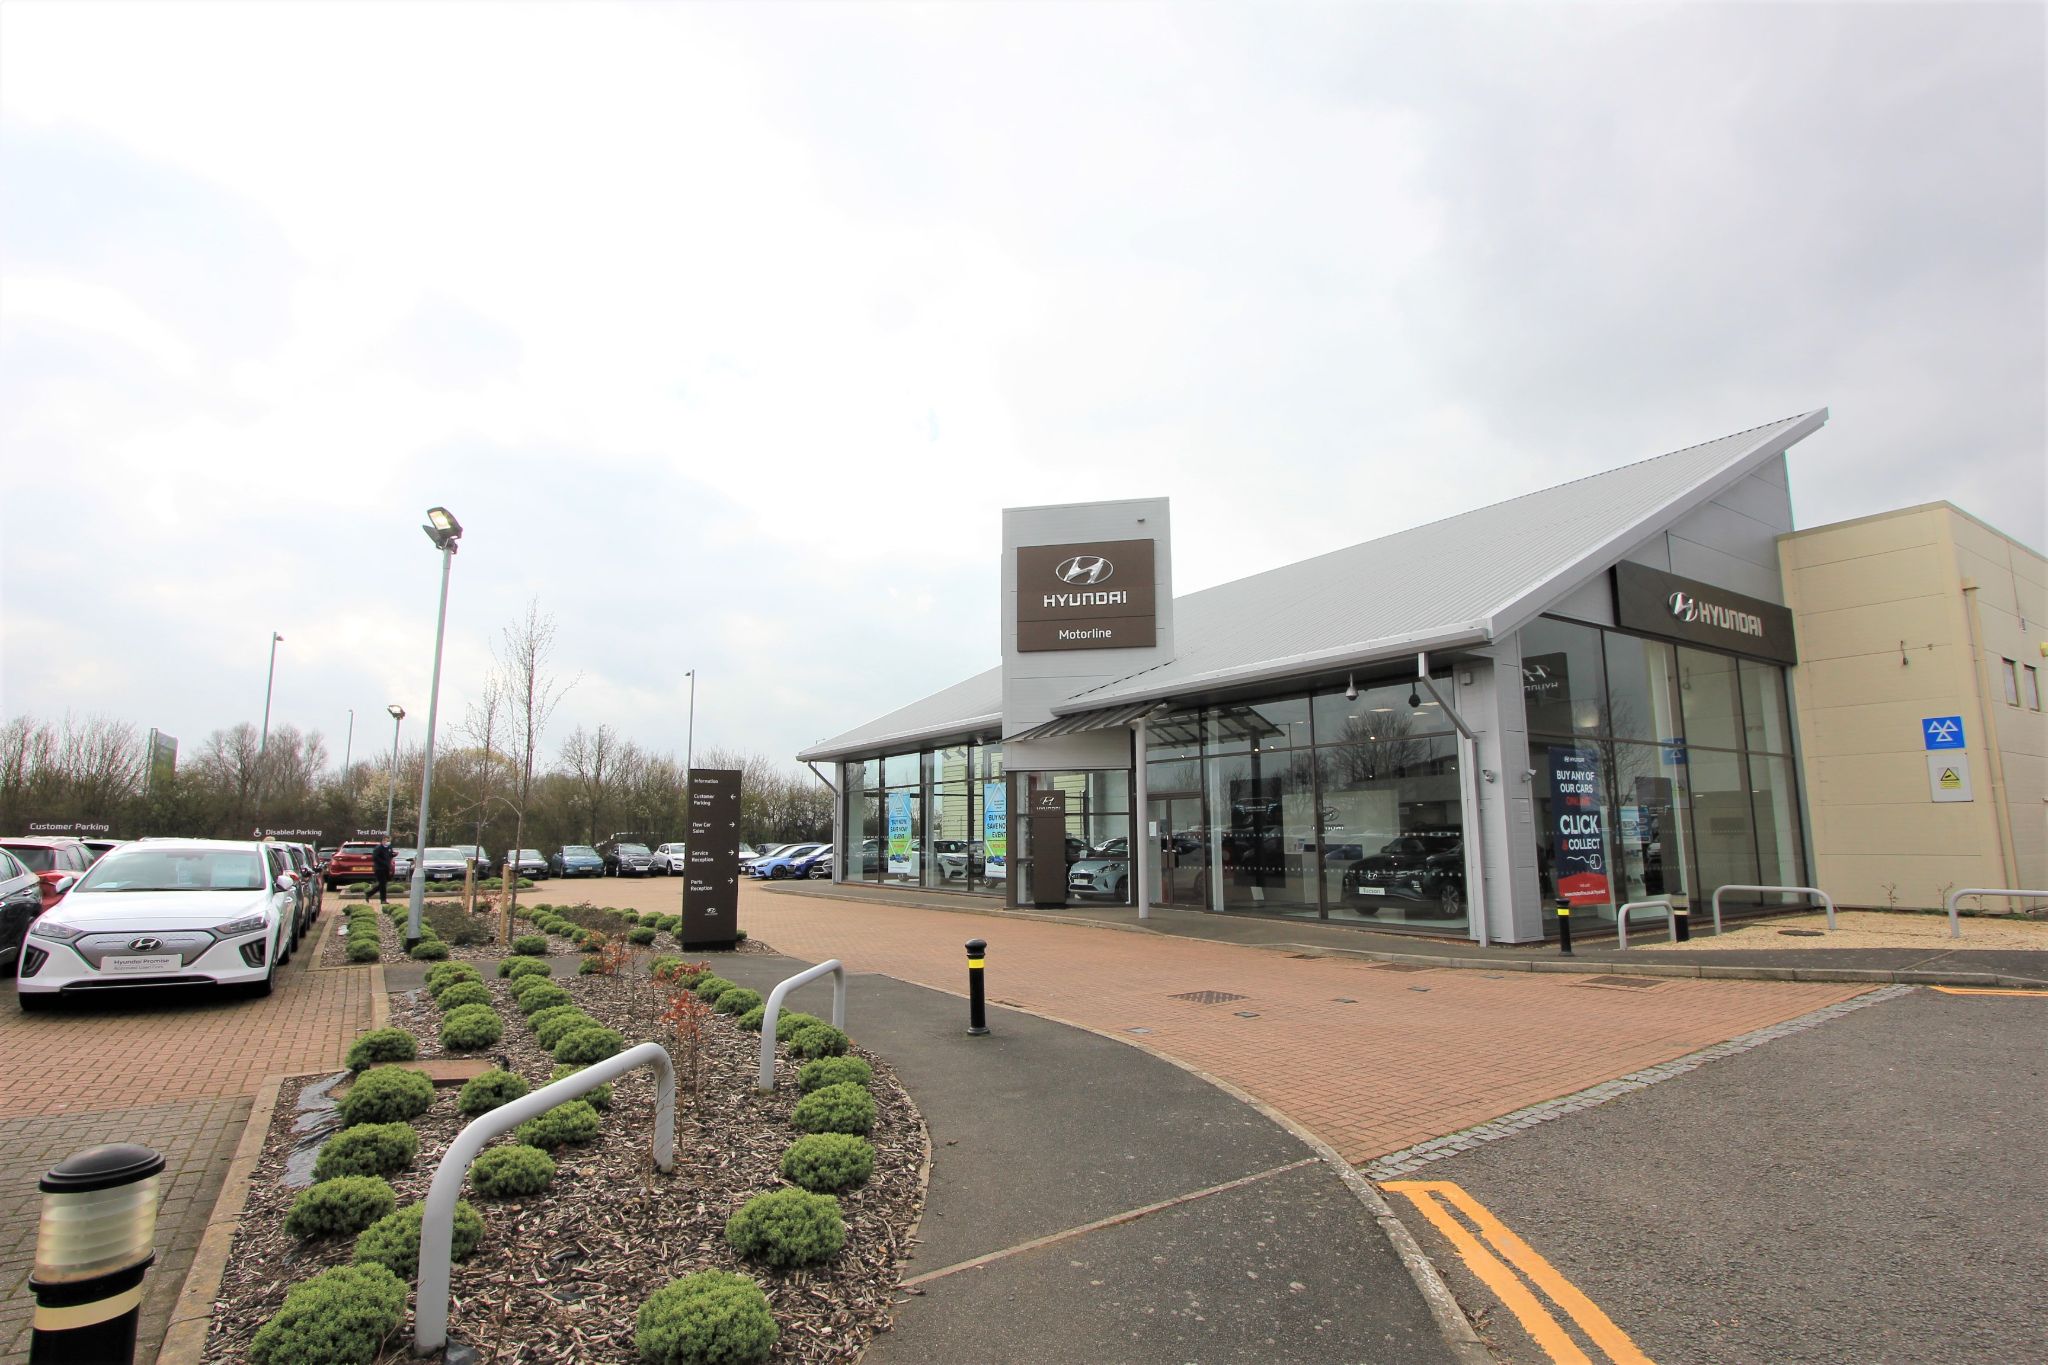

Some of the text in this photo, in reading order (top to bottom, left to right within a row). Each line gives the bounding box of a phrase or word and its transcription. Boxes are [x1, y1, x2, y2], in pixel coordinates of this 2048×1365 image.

[1043, 590, 1127, 608] HYUNDAI
[1699, 601, 1763, 637] HYUNDAI
[1059, 628, 1112, 640] Motorline
[1556, 770, 1595, 781] BUY ANY OF
[1560, 783, 1594, 794] OUR CARS
[30, 822, 110, 832] Customer Parking
[987, 822, 998, 830] SAVE
[1560, 814, 1600, 835] CLICK
[296, 829, 322, 837] Parking
[1568, 838, 1601, 851] COLLECT
